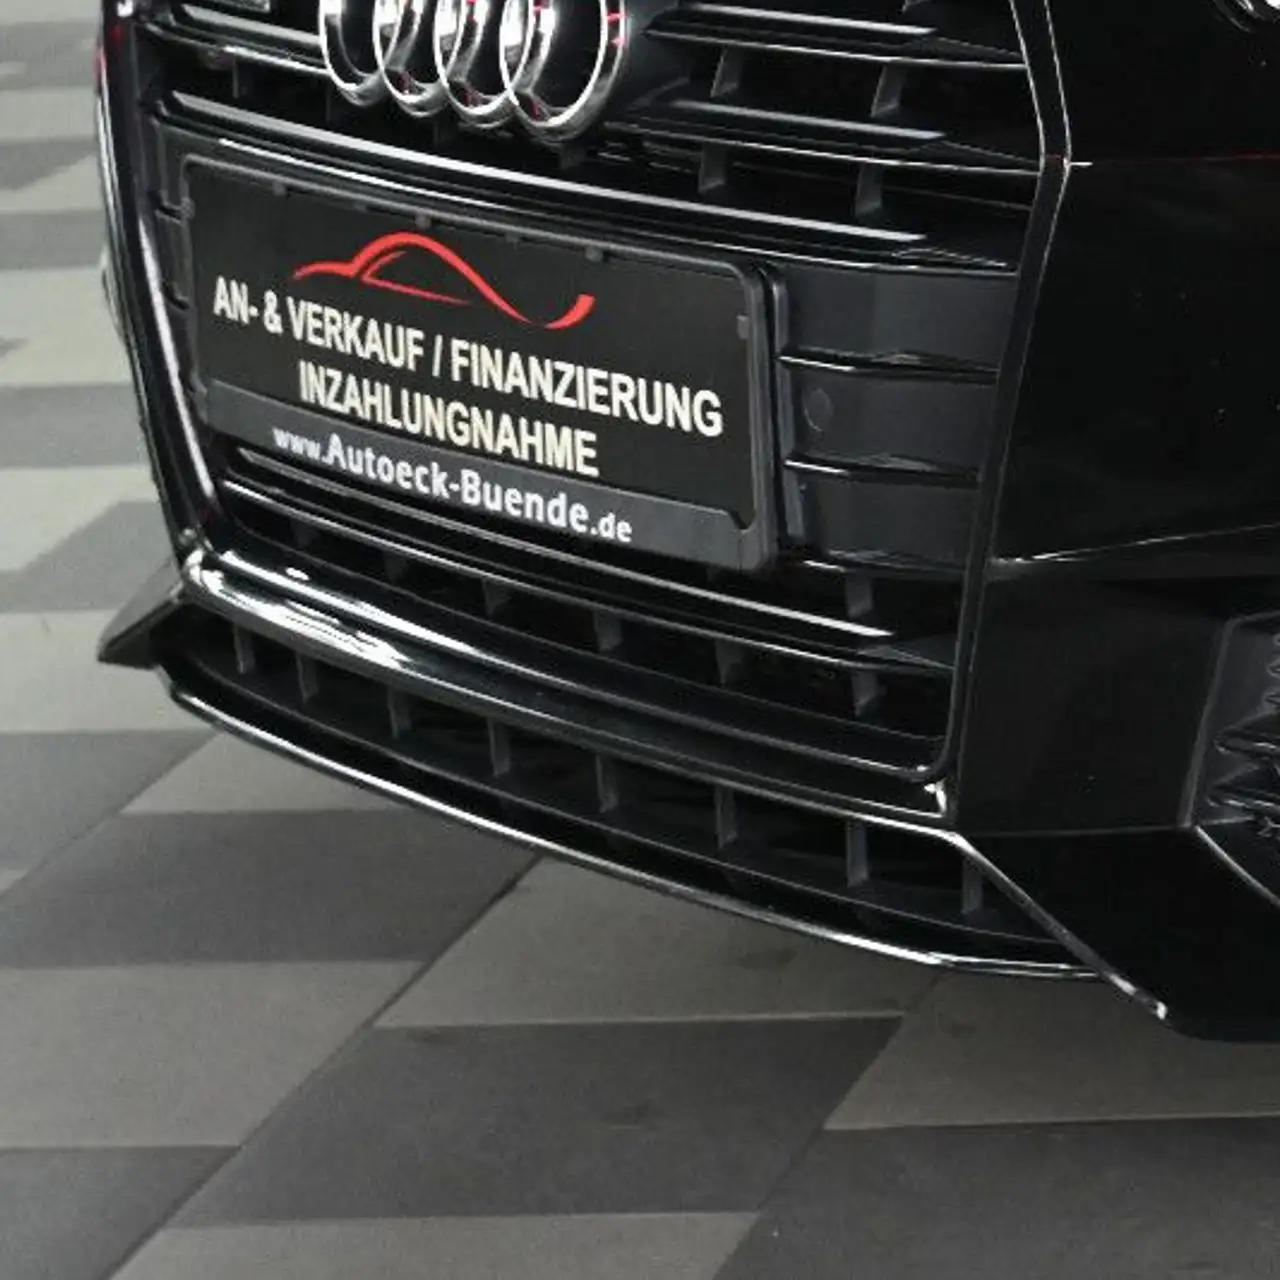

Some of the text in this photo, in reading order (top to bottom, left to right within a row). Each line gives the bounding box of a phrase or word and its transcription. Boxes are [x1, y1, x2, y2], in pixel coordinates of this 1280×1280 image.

[213, 275, 724, 438] AN- & VERKAUF / FINANZIERUNG
[299, 359, 600, 477] INZAHLUNGNAHME
[271, 426, 634, 544] www.Autoeck-Buende.de
